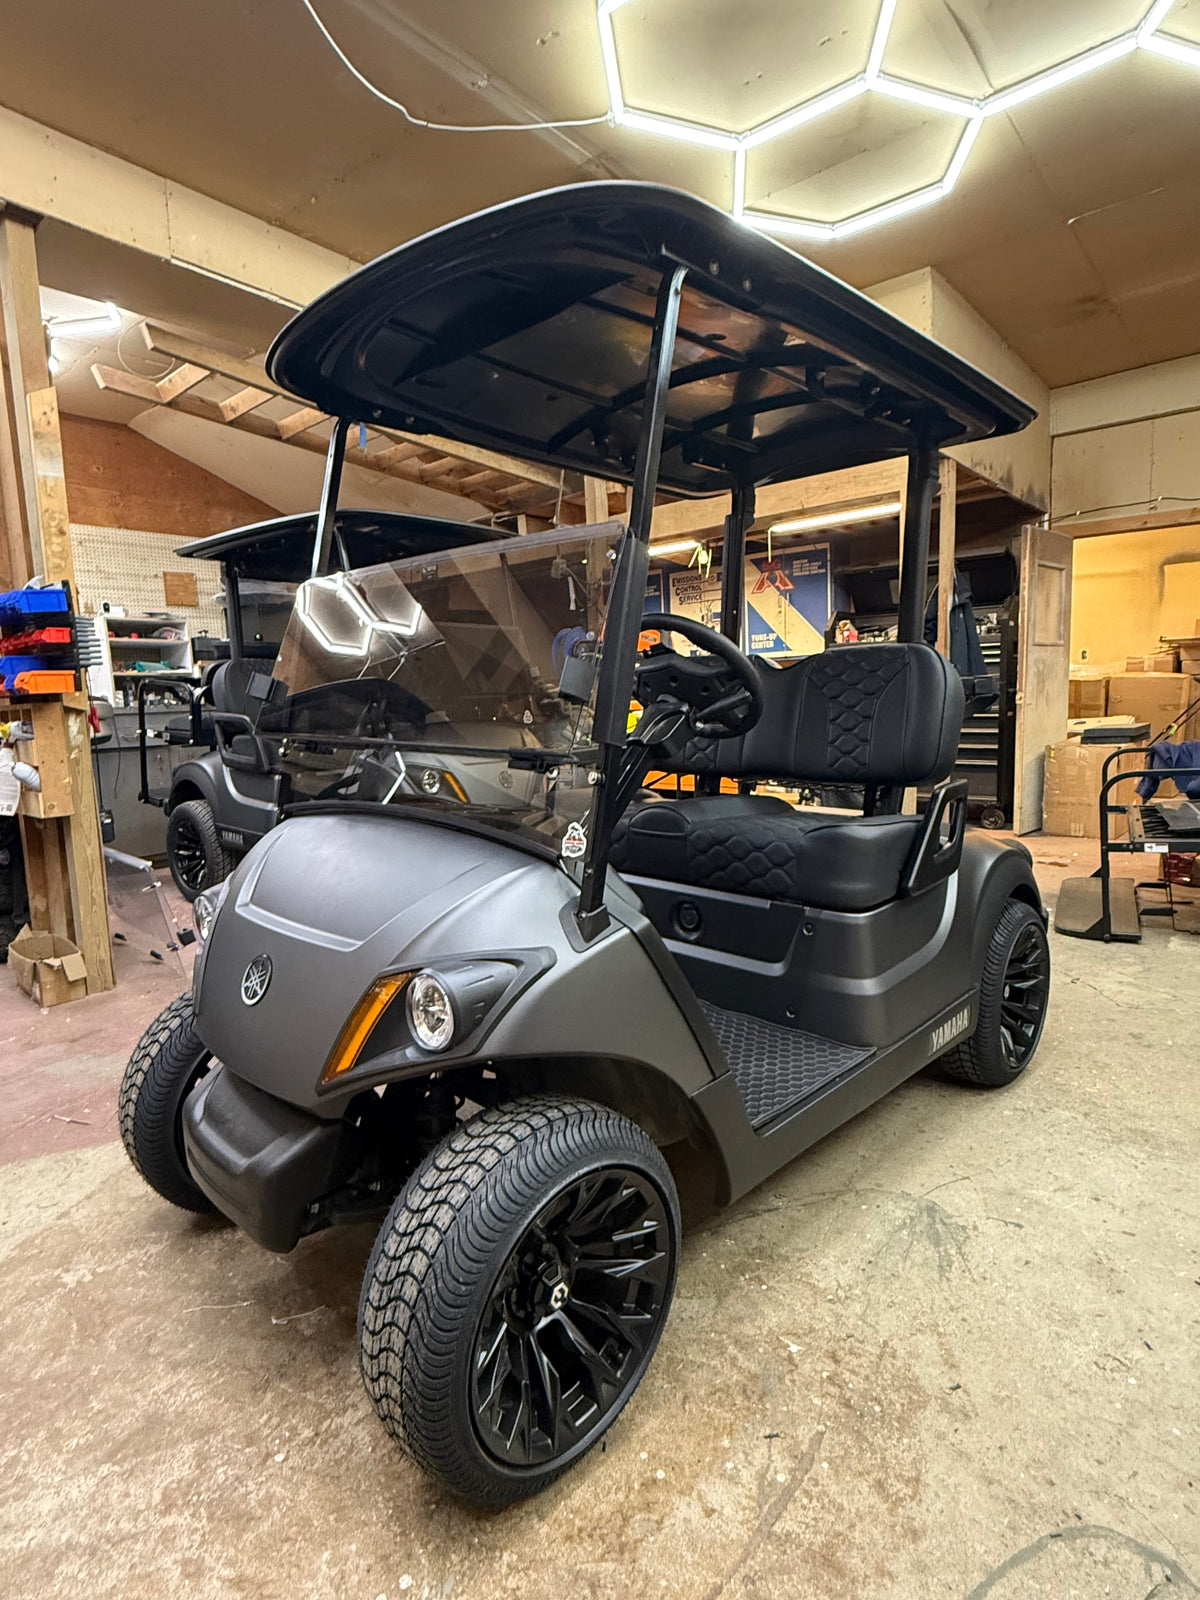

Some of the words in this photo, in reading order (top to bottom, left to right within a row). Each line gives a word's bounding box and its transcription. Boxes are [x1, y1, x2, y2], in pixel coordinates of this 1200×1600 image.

[672, 574, 702, 587] EMISSIONS
[675, 585, 702, 596] CONTROL
[679, 594, 702, 605] SERVICE
[751, 632, 778, 642] TUNE-UP
[751, 640, 774, 649] CENTER
[932, 1008, 968, 1052] YAMAHA
